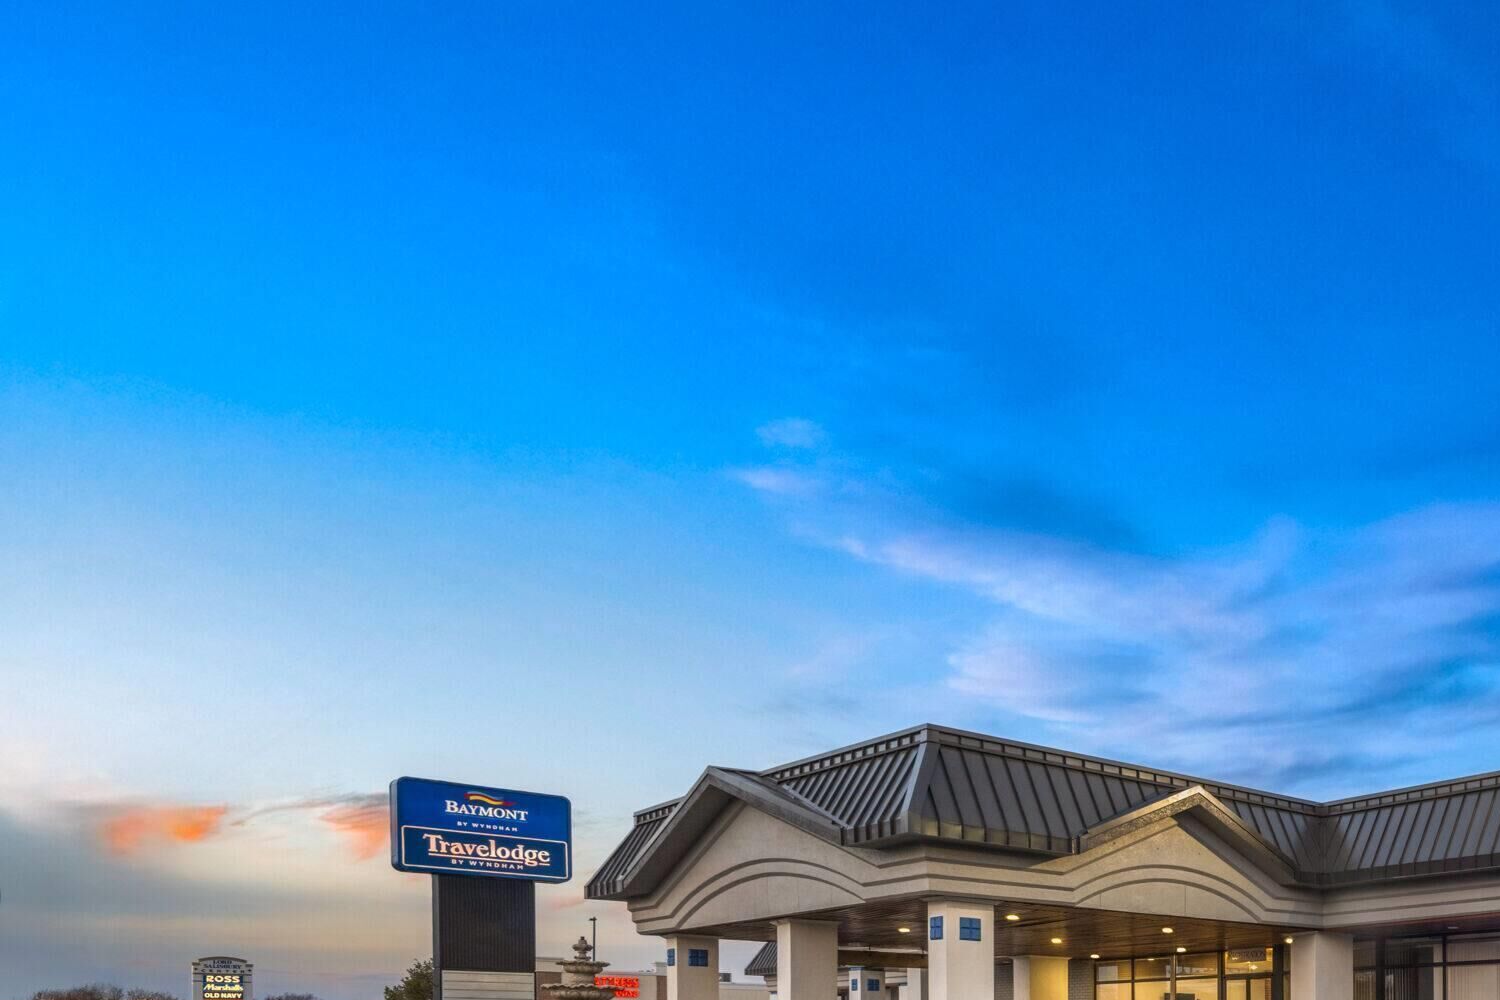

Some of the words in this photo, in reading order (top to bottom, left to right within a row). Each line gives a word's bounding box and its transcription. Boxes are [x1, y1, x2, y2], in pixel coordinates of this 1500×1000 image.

[445, 800, 528, 821] BAYMONT
[472, 823, 518, 832] WYNDHAM
[423, 833, 550, 867] Travelodge
[451, 858, 464, 866] BY
[470, 860, 524, 870] WYNDHAM
[206, 975, 240, 983] ROSS
